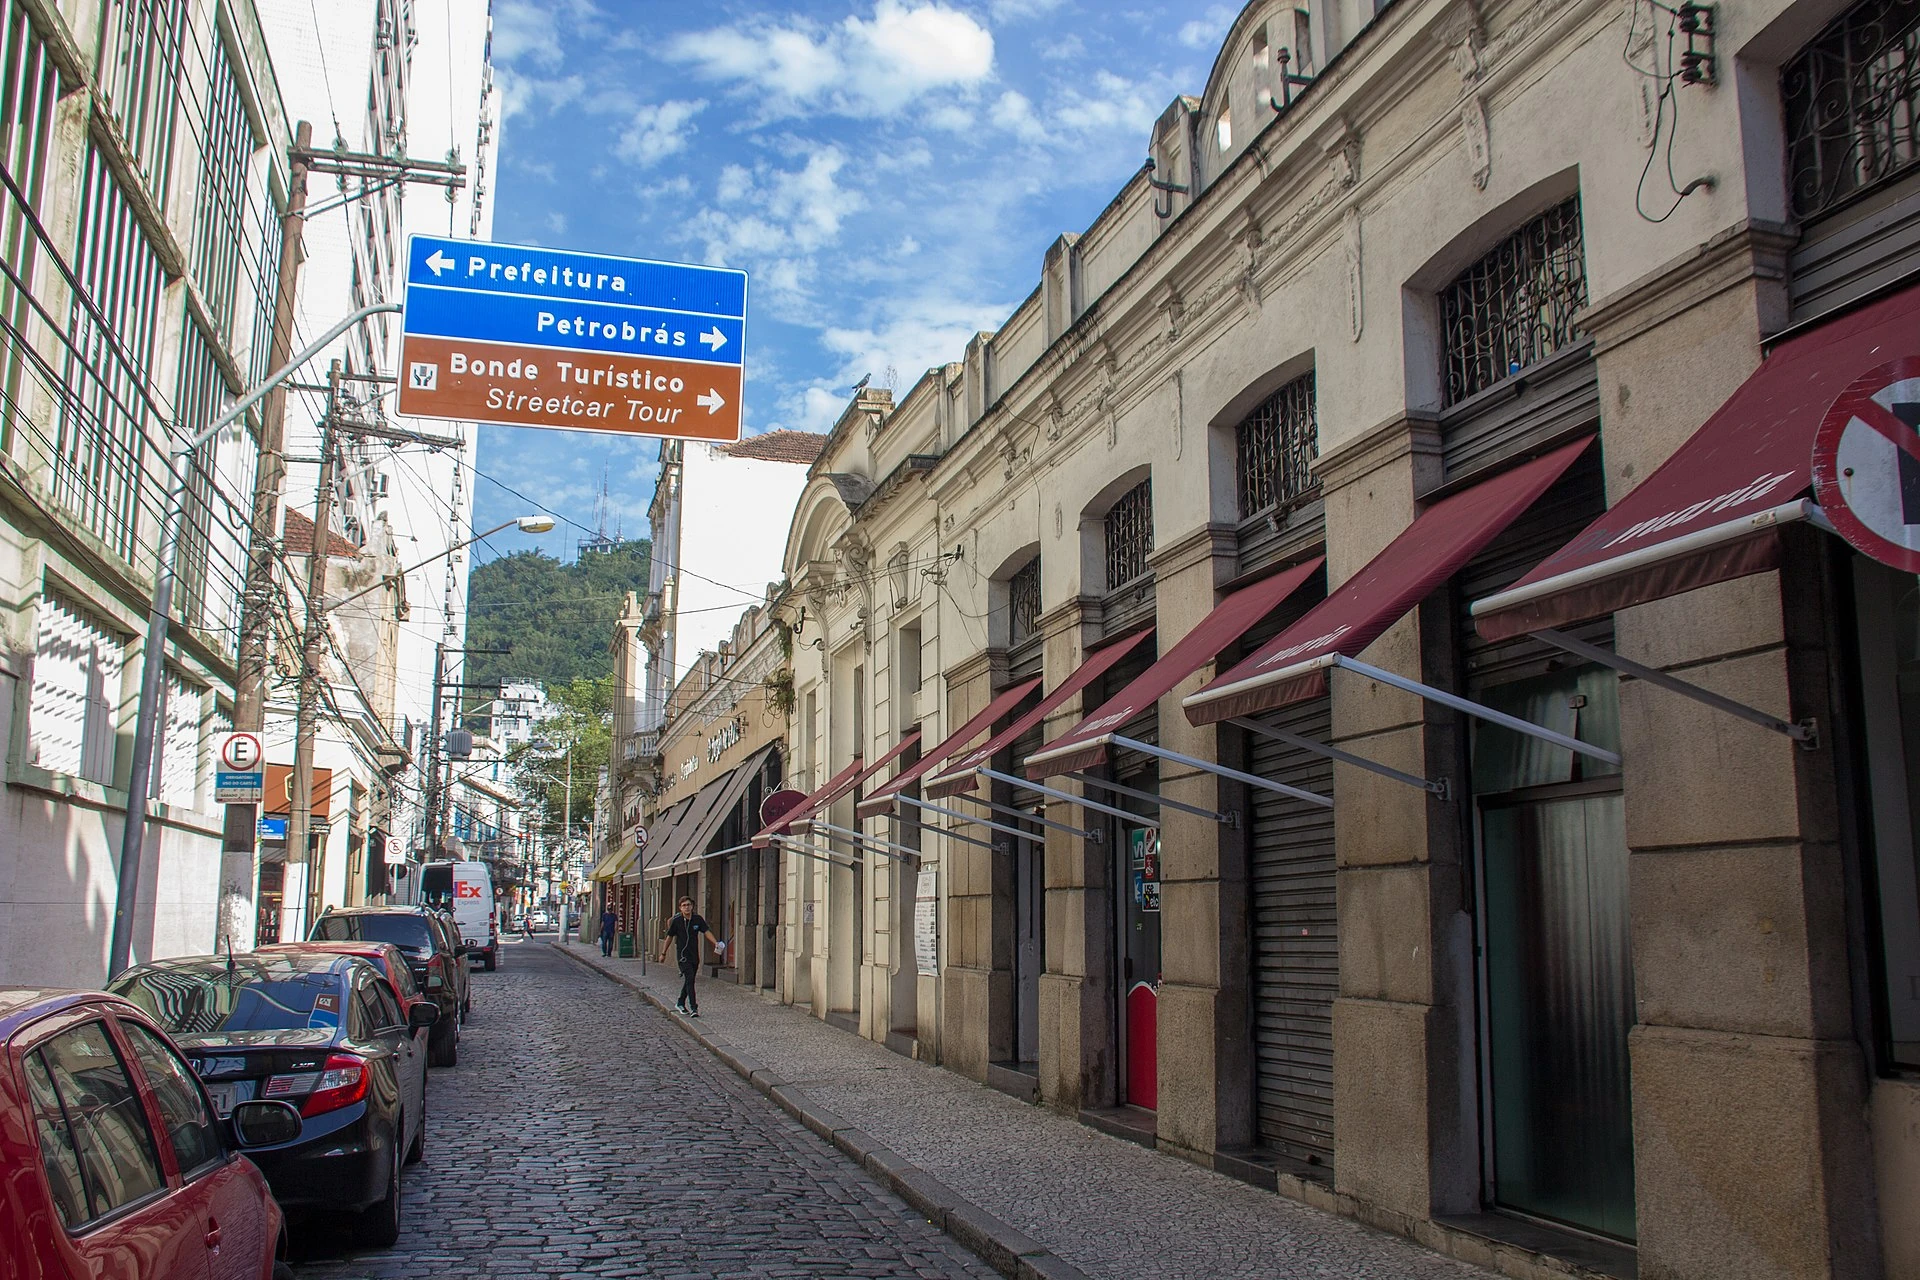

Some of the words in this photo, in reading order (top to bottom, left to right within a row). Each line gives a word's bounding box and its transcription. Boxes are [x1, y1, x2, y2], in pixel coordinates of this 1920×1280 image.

[468, 256, 626, 292] Prefeitura
[537, 311, 687, 346] Petrobrás
[450, 352, 539, 381] Bonde
[556, 360, 685, 393] Turístico
[486, 387, 615, 418] Streetcar
[627, 399, 683, 424] Tour
[234, 742, 247, 761] E
[453, 881, 482, 898] Ex
